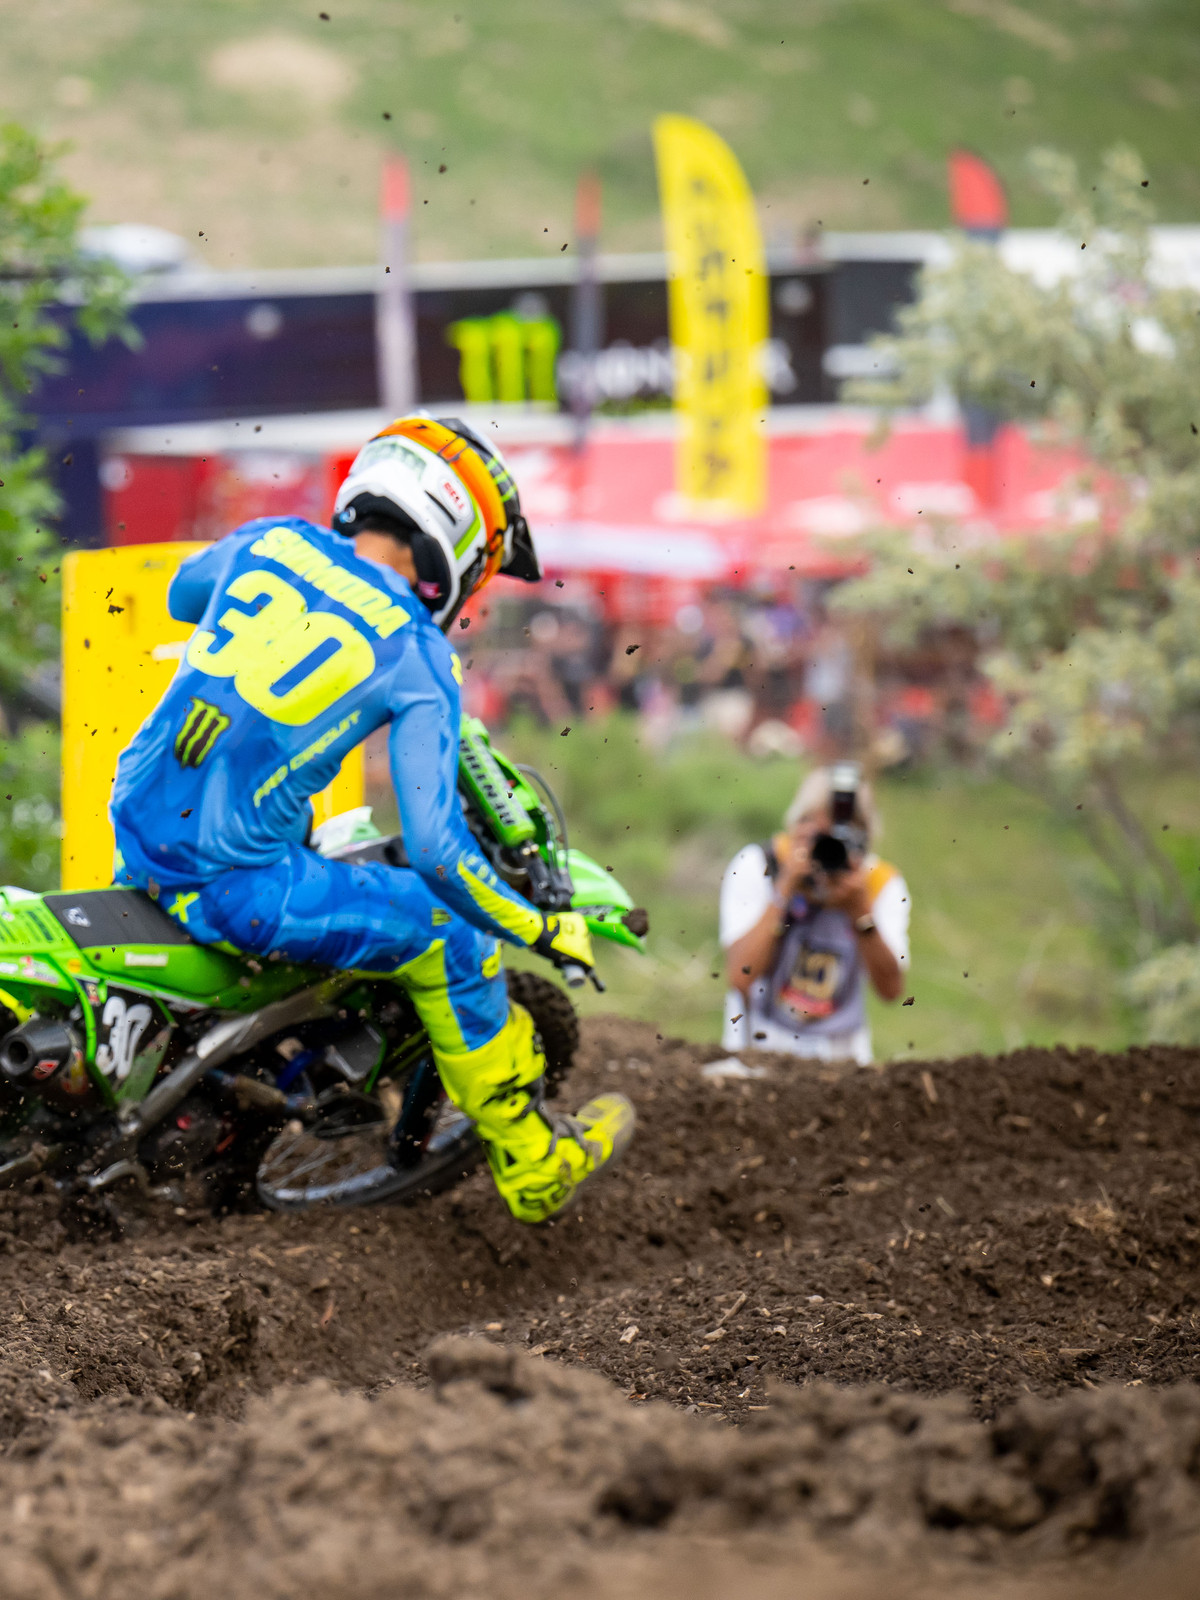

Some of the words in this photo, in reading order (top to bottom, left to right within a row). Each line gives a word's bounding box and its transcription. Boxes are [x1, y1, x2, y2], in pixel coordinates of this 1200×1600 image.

[249, 526, 412, 640] SHIMODA
[186, 569, 376, 726] 30
[95, 995, 152, 1080] 30
